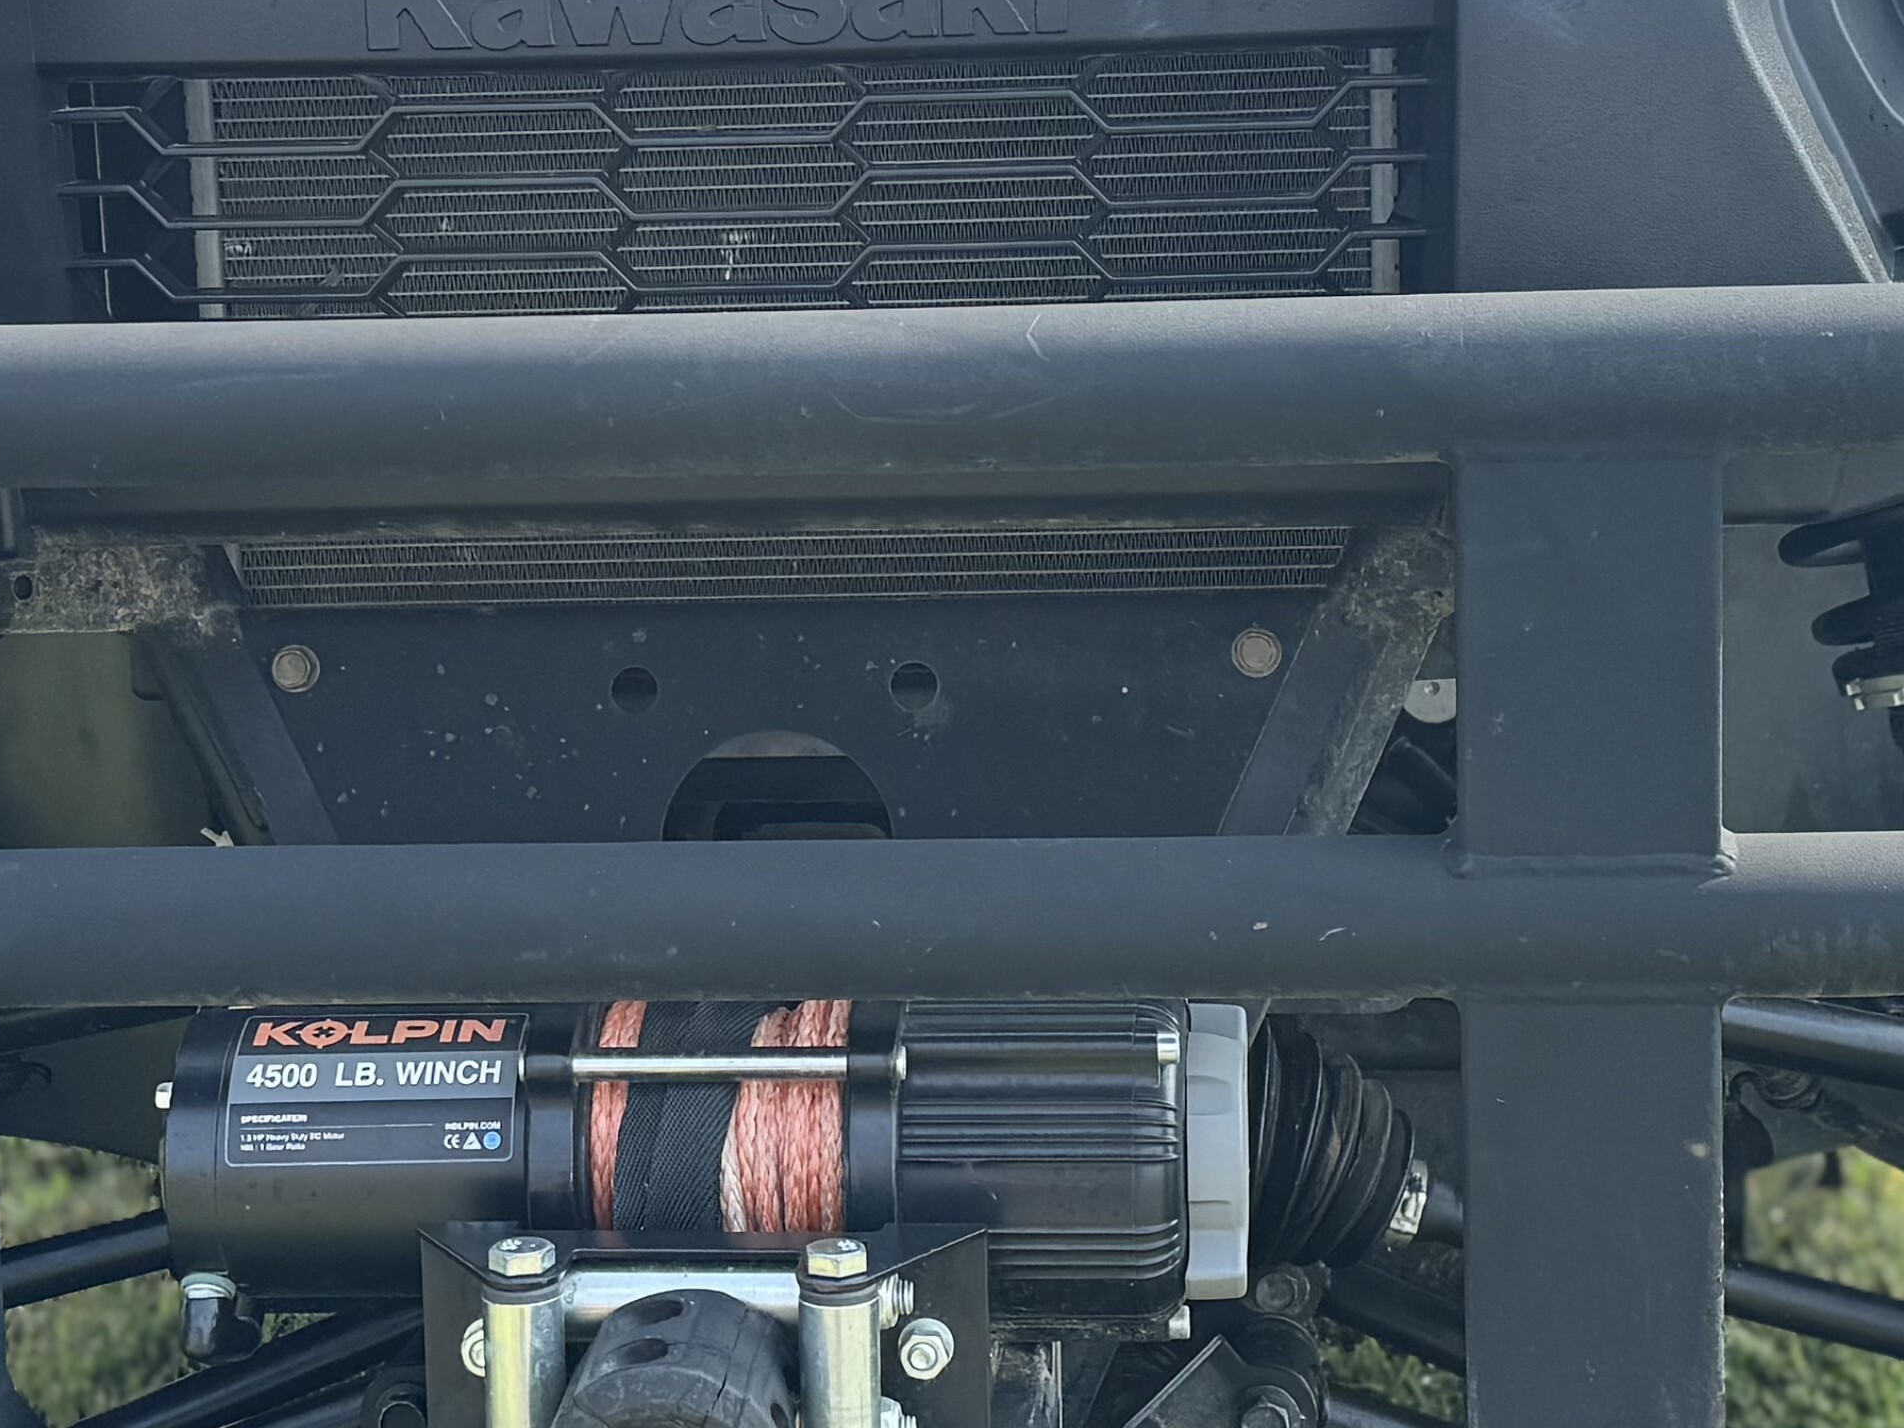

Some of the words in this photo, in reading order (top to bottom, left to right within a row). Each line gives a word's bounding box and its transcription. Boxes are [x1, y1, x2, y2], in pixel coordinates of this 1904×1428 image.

[253, 1018, 507, 1049] KOLPIN
[246, 1063, 317, 1088] 4500
[335, 1062, 385, 1087] LB.
[396, 1060, 502, 1086] WINCH
